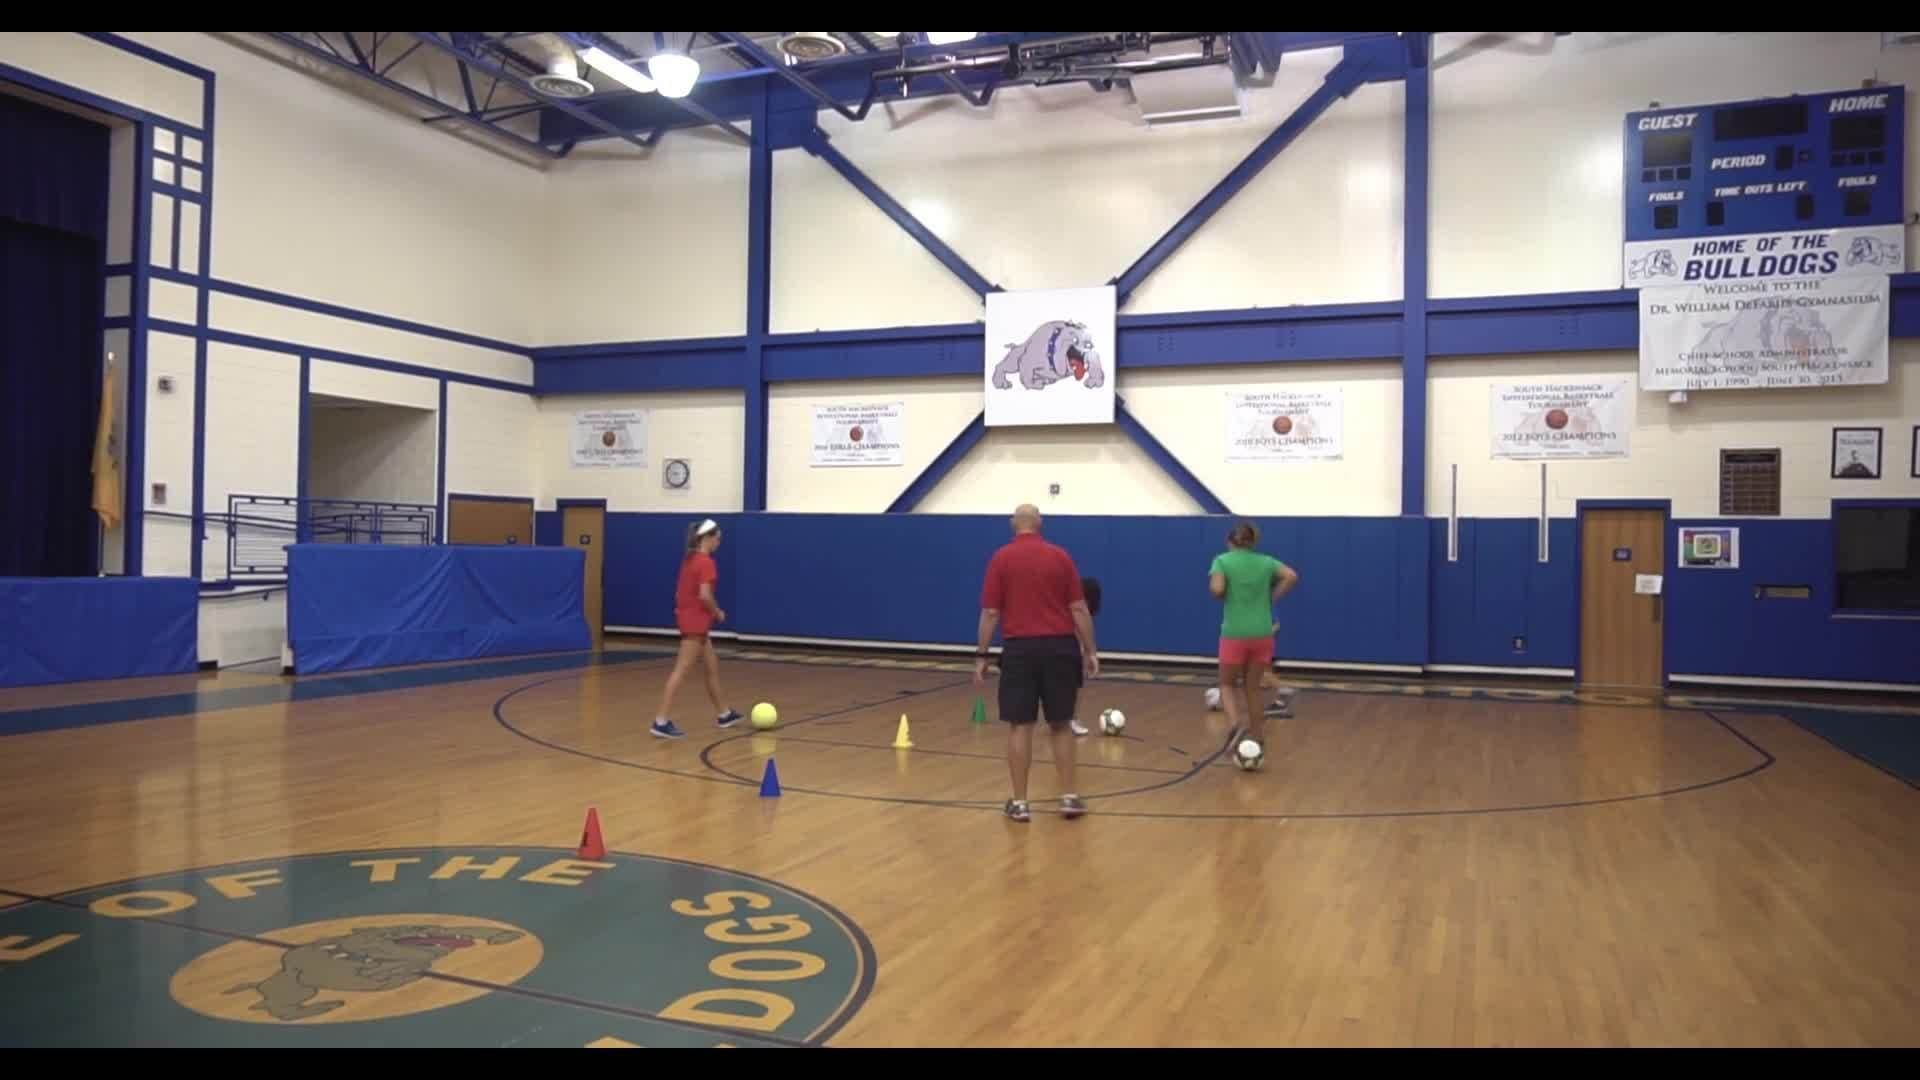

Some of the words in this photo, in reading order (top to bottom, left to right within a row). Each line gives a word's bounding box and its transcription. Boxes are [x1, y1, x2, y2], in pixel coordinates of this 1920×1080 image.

[1829, 94, 1888, 113] HOME
[1638, 113, 1698, 131] GUEST
[1711, 154, 1767, 170] PERIOD
[1714, 186, 1741, 197] TIME
[1745, 183, 1774, 195] OUTS
[1777, 181, 1807, 193] LEFT
[1837, 175, 1878, 187] FOULS
[1648, 191, 1684, 202] FOULS
[1692, 239, 1747, 255] HOME
[1756, 236, 1781, 251] OF
[1791, 234, 1830, 249] THE
[1683, 251, 1840, 281] BULLDOGS
[1704, 281, 1767, 295] WELCOME
[1773, 280, 1791, 291] TO
[1794, 279, 1820, 291] THE
[1675, 301, 1730, 314] WILLIAM
[89, 868, 285, 919] OF
[350, 856, 616, 886] THE
